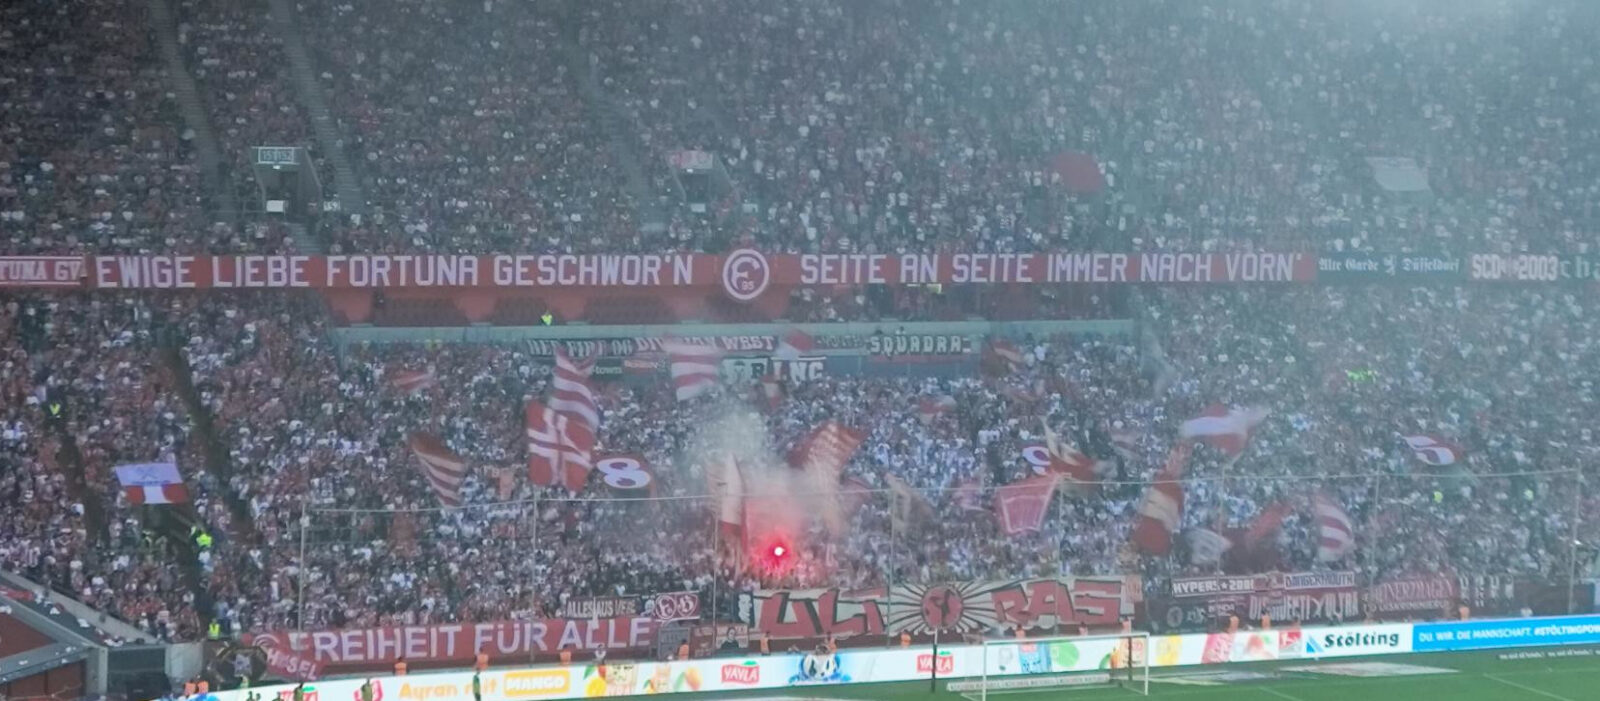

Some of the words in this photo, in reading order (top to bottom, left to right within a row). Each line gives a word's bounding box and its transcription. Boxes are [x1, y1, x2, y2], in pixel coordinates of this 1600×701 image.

[96, 256, 195, 288] EWIGE
[212, 256, 309, 287] LIEBE
[327, 255, 478, 287] FORTUNA
[493, 254, 692, 286] GESCHWOR'N
[800, 254, 886, 284] SEITE
[900, 254, 938, 284] AN
[952, 254, 1033, 283] SEITE
[1047, 254, 1127, 282] IMMER
[1140, 253, 1211, 282] NACH
[1318, 257, 1341, 271] Alte
[1345, 257, 1379, 271] Garde
[1402, 257, 1460, 273] Düsseldorf
[1472, 254, 1500, 279] SCD
[1518, 254, 1558, 281] 2003
[721, 336, 774, 352] WEST
[869, 335, 962, 355] SQUADRA
[597, 457, 651, 489] 8
[1173, 580, 1220, 594] HYPERS
[566, 600, 595, 618] ALLES
[597, 600, 614, 617] AUS
[474, 619, 548, 657] FÜR
[557, 616, 653, 652] ALLE
[1324, 630, 1400, 649] Stölting
[1457, 629, 1473, 641] DIE
[267, 648, 318, 681] HSEL
[919, 657, 952, 672] YALA
[399, 682, 458, 699] Ayran
[465, 677, 497, 694] it
[507, 676, 565, 692] MANGO
